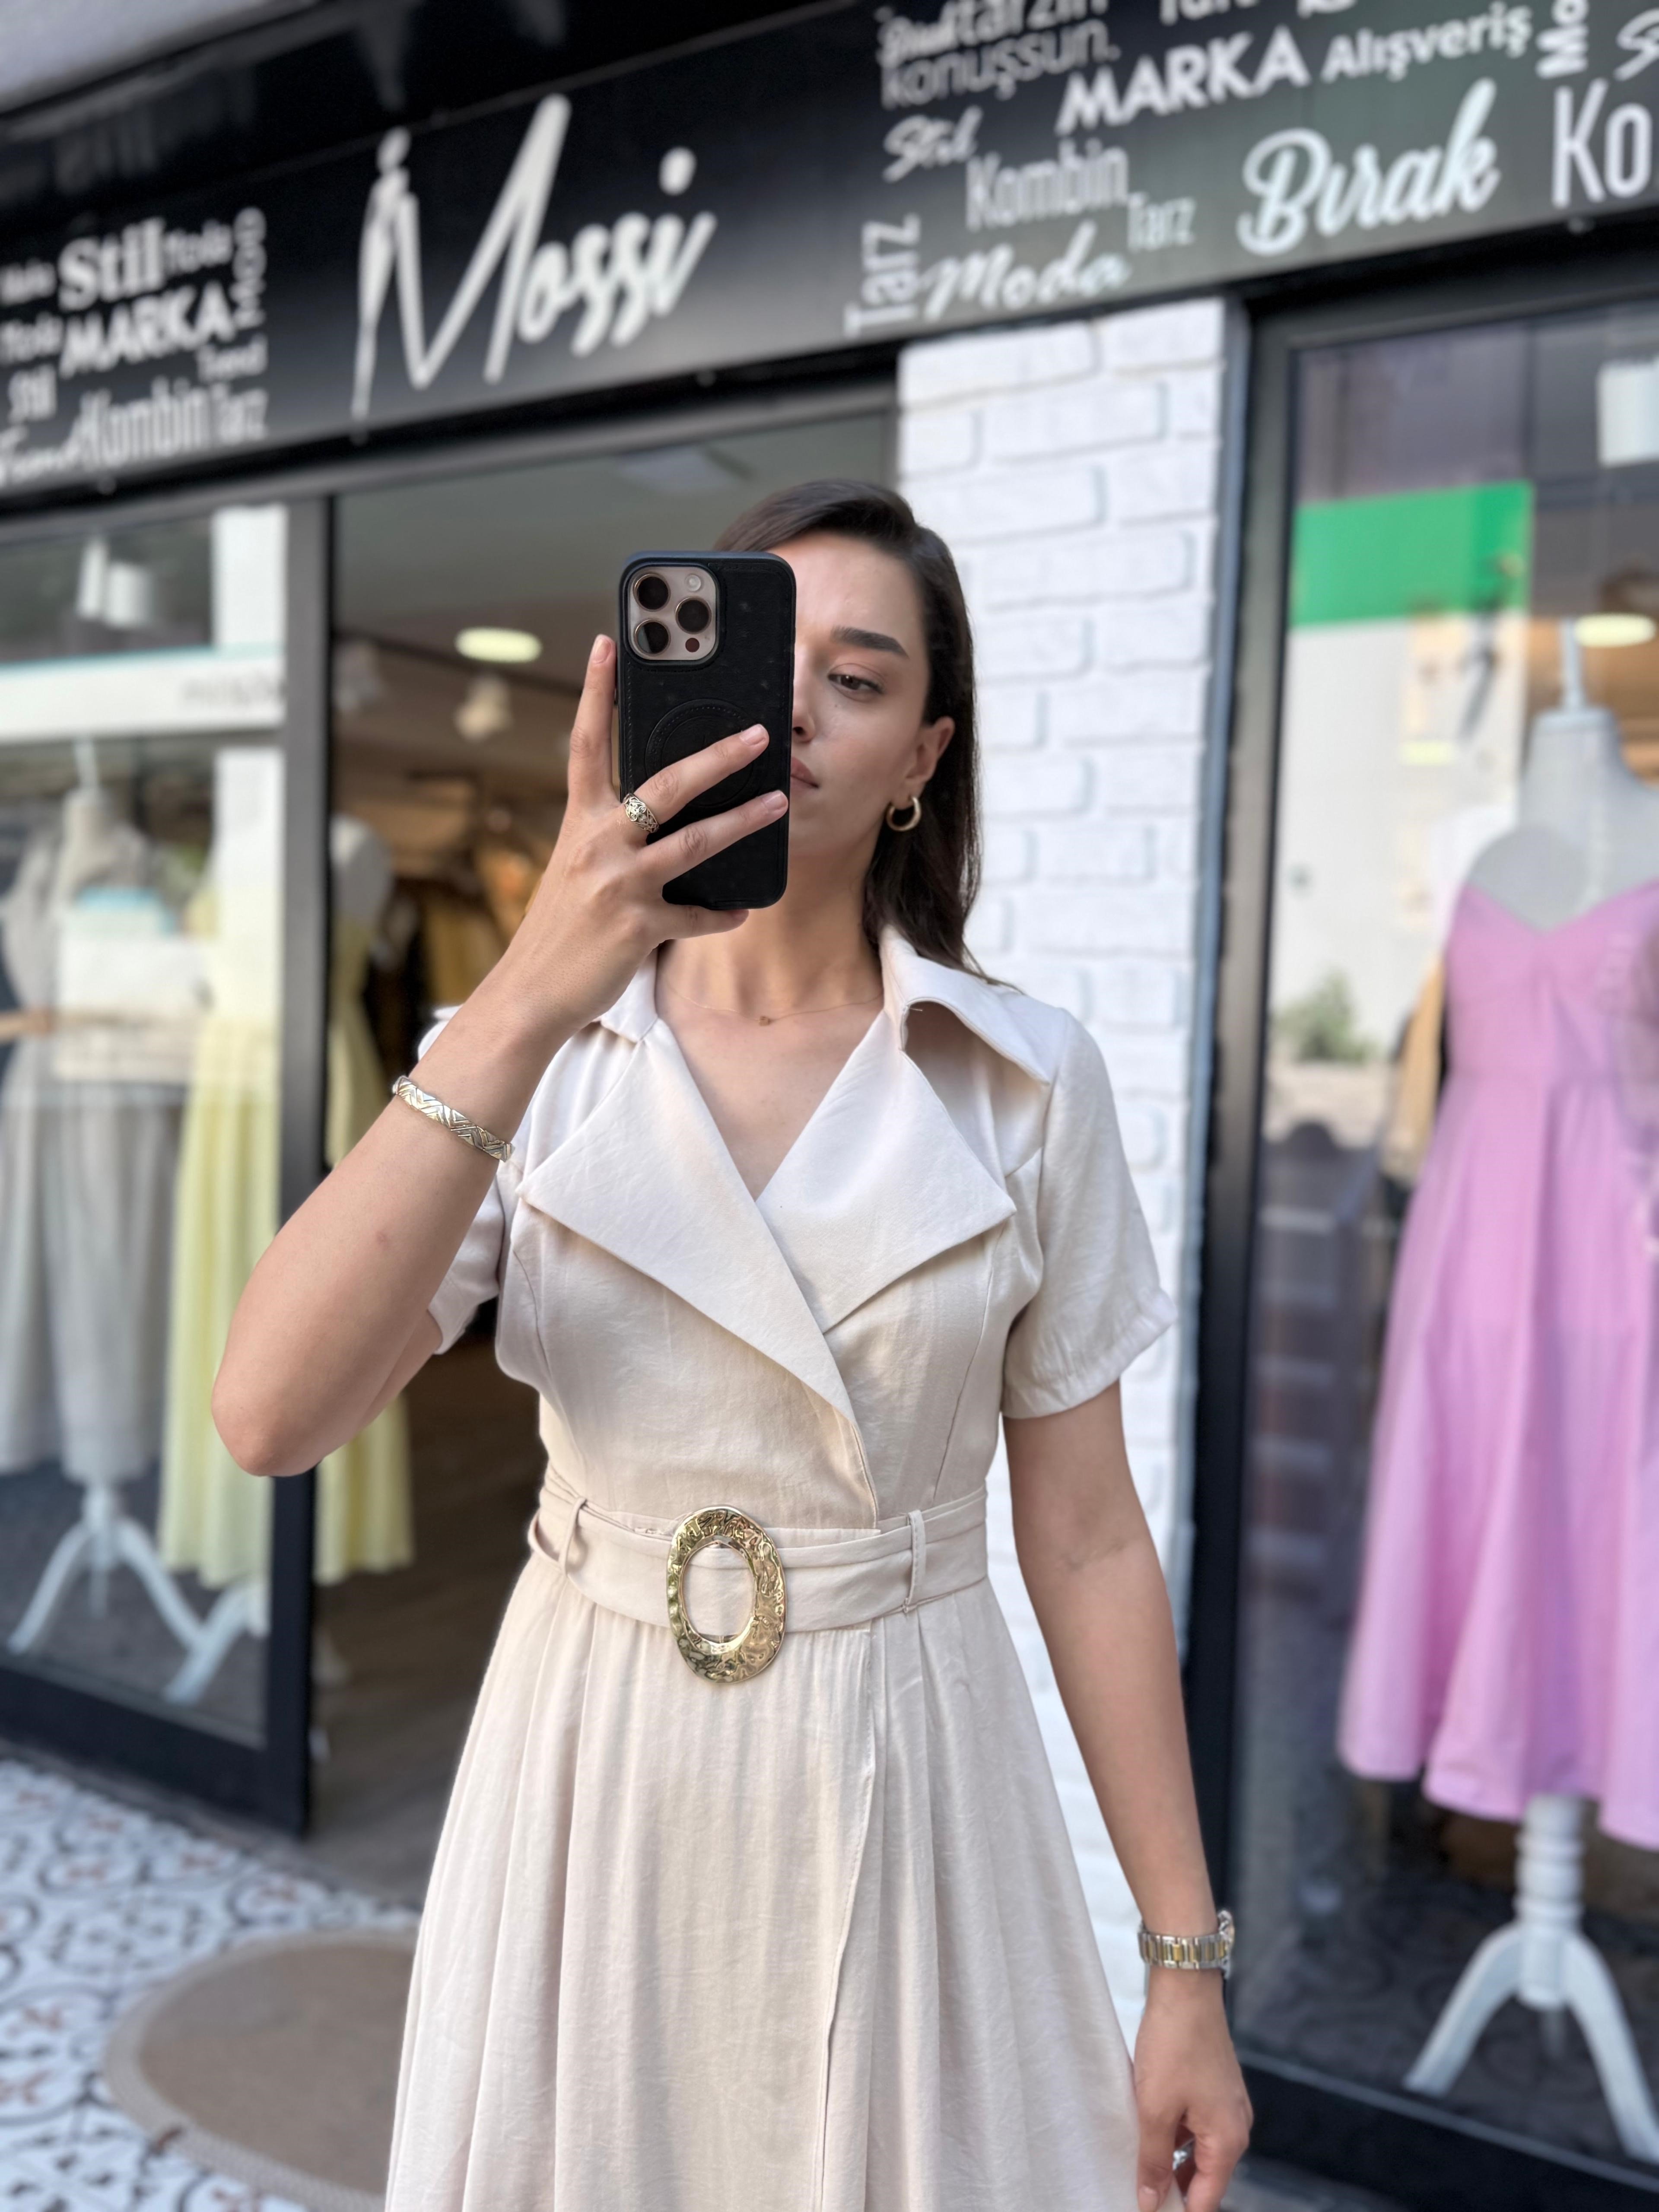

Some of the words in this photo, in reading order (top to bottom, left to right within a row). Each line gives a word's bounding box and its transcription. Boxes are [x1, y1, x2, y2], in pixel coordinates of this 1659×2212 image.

[1055, 24, 1312, 136] MARKA
[1321, 2, 1532, 82] Alışveriş
[966, 138, 1128, 231] Kombin
[1236, 78, 1501, 255] Bırak
[58, 217, 165, 311] Stil
[1128, 191, 1196, 252] Tarz
[844, 212, 921, 337] Tarz
[920, 219, 1131, 322] Moda
[59, 281, 235, 379] MARKA
[81, 376, 211, 470] Kombin
